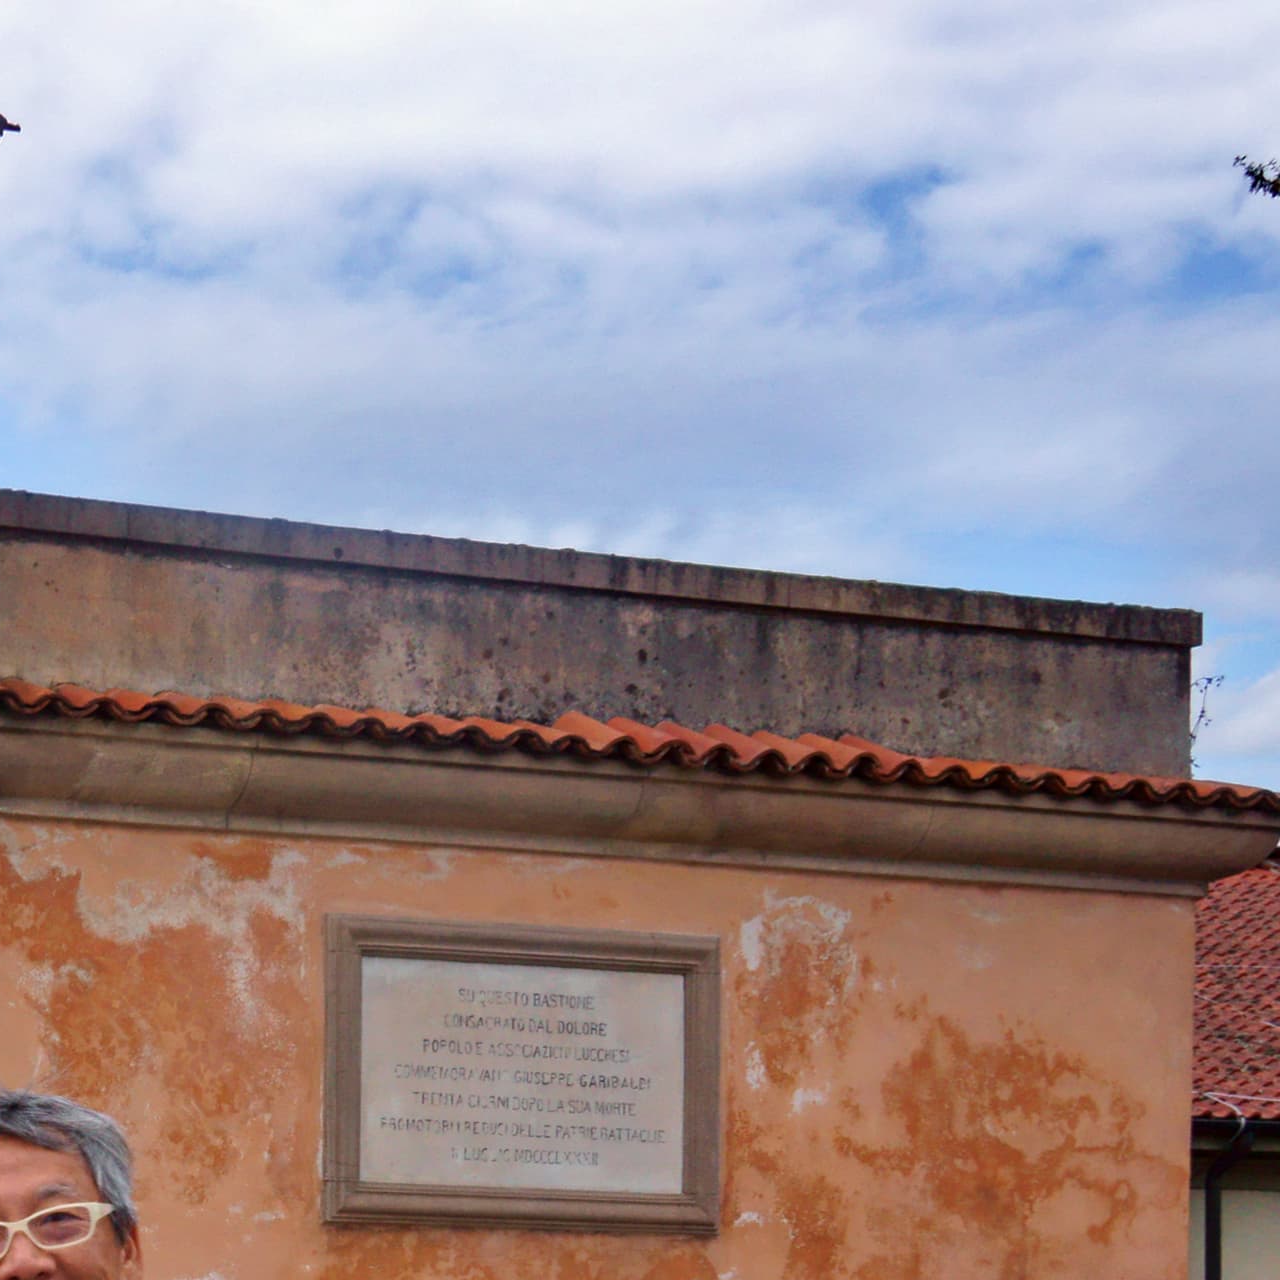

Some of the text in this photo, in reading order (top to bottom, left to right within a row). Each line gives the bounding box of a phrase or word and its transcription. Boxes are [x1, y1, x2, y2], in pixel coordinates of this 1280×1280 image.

[458, 988, 595, 1010] SU QUESTO BASTIONE
[529, 1018, 553, 1034] DAL
[557, 1020, 608, 1037] DOLORE
[422, 1038, 473, 1055] POPOLO
[475, 1041, 484, 1056] E
[513, 1069, 575, 1088] GIUSEPPE
[579, 1073, 652, 1091] GARIBALDI
[567, 1099, 592, 1115] SUA
[595, 1101, 637, 1117] MORTE
